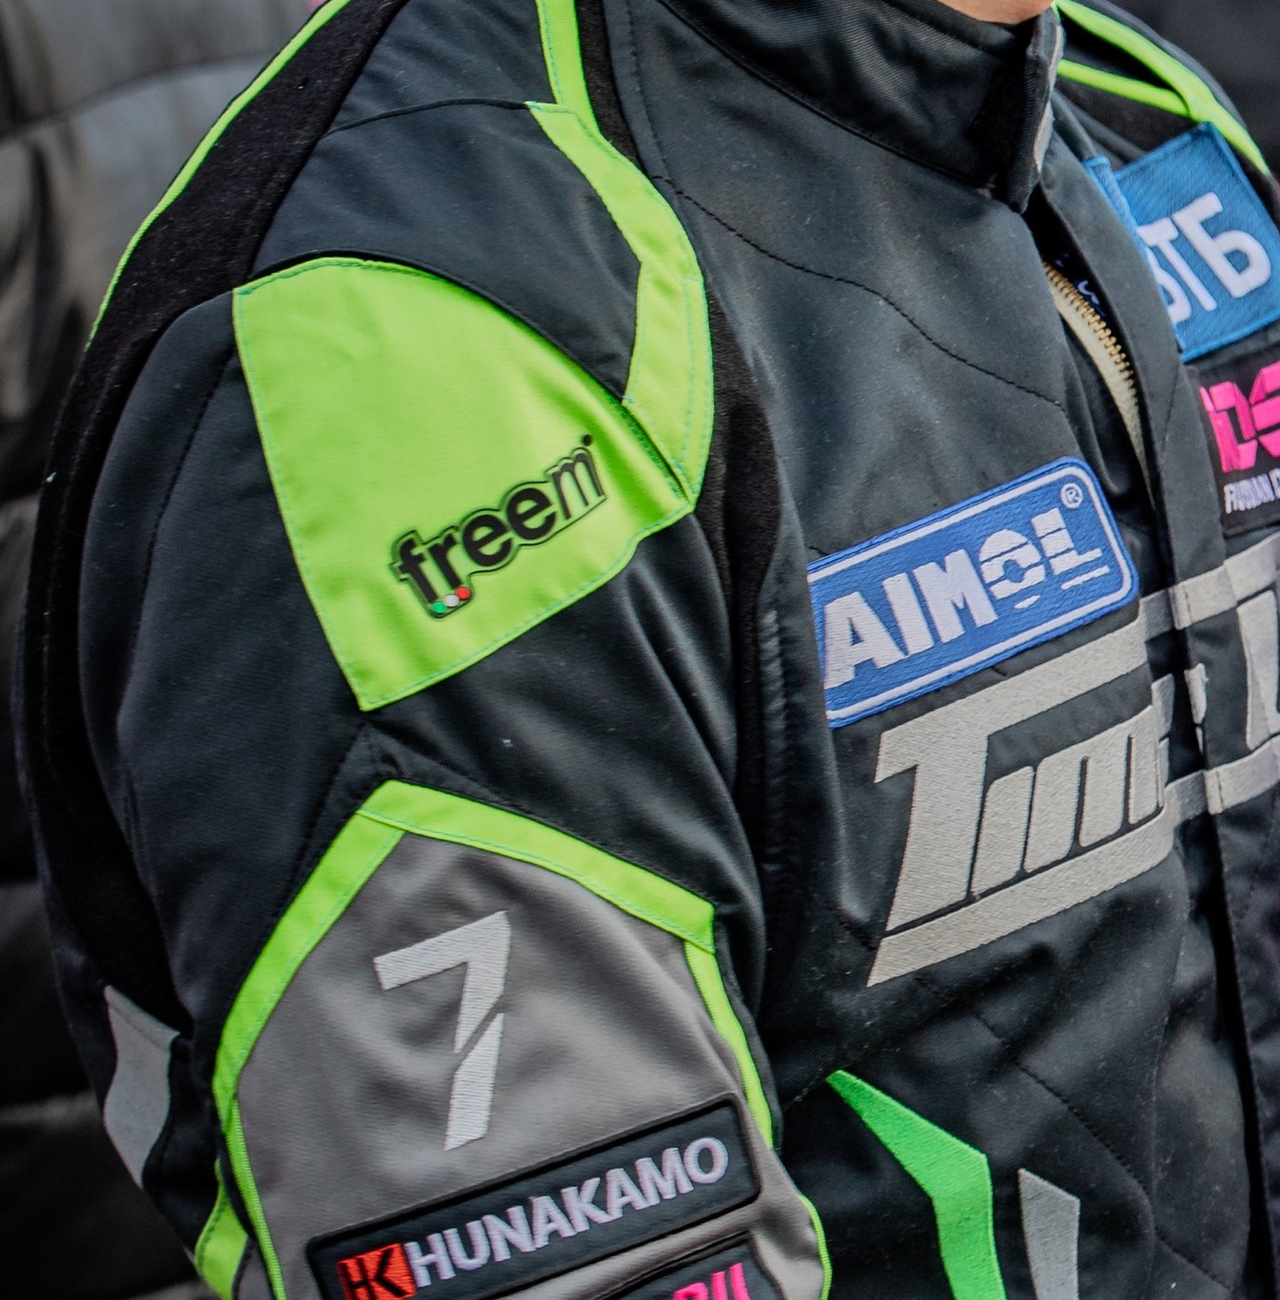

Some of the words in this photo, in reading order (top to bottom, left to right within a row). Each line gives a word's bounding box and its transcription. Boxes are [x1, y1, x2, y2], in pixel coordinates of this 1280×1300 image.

[394, 446, 607, 607] freem
[823, 506, 1110, 690] AIMOL
[372, 910, 511, 1152] 7
[403, 1136, 729, 1289] HUNAKAMO
